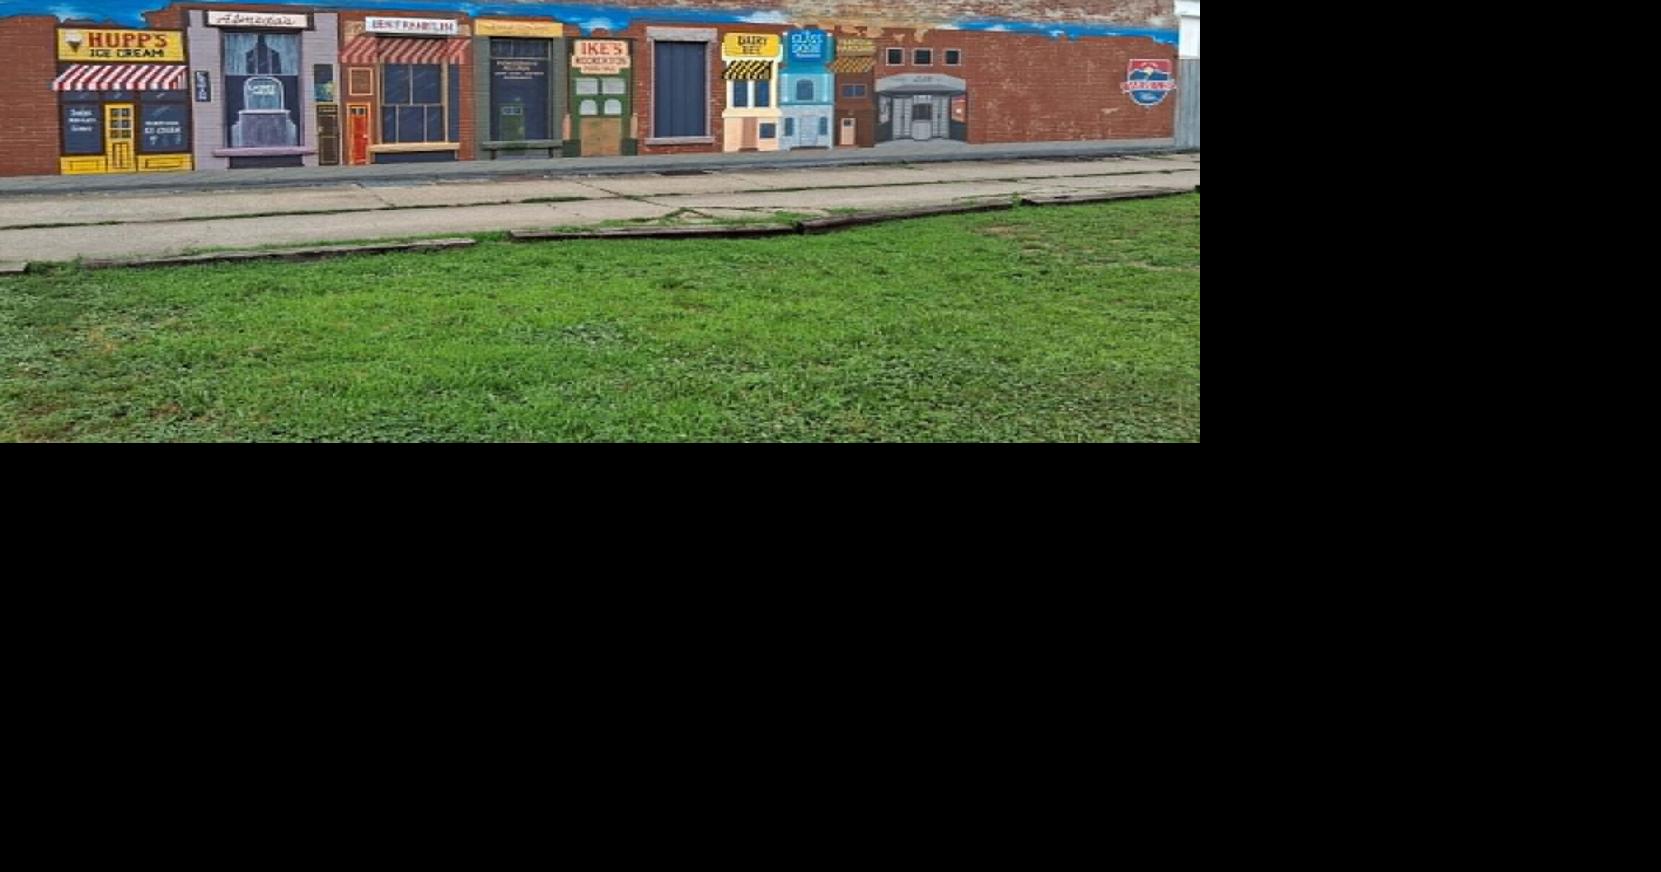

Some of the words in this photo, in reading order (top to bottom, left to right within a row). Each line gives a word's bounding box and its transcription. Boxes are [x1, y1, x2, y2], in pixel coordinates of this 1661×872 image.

[88, 32, 168, 48] HUPP'S
[90, 49, 111, 58] ICE
[116, 49, 165, 58] CREAM
